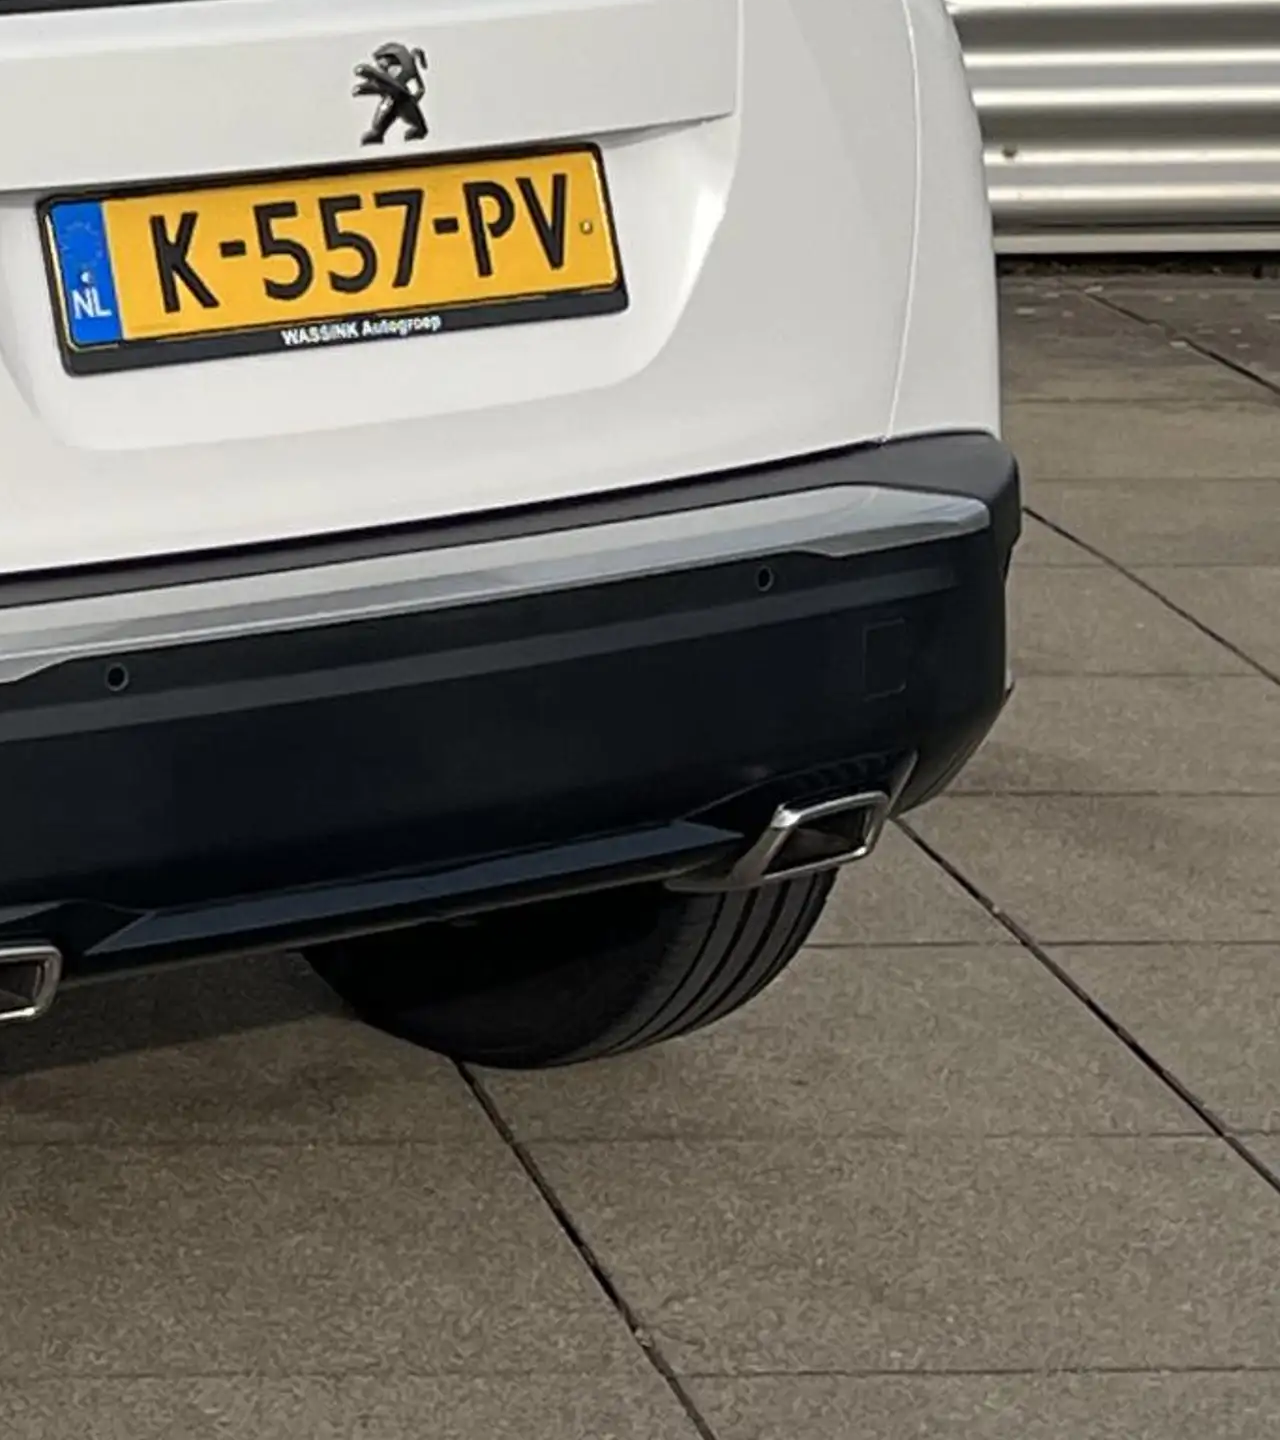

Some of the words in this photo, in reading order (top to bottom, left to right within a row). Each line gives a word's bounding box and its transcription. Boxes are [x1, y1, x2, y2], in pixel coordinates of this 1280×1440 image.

[149, 173, 568, 314] K-557-PV
[71, 286, 113, 320] NL
[280, 321, 359, 346] WASSINK
[362, 315, 441, 337] Autogroep
